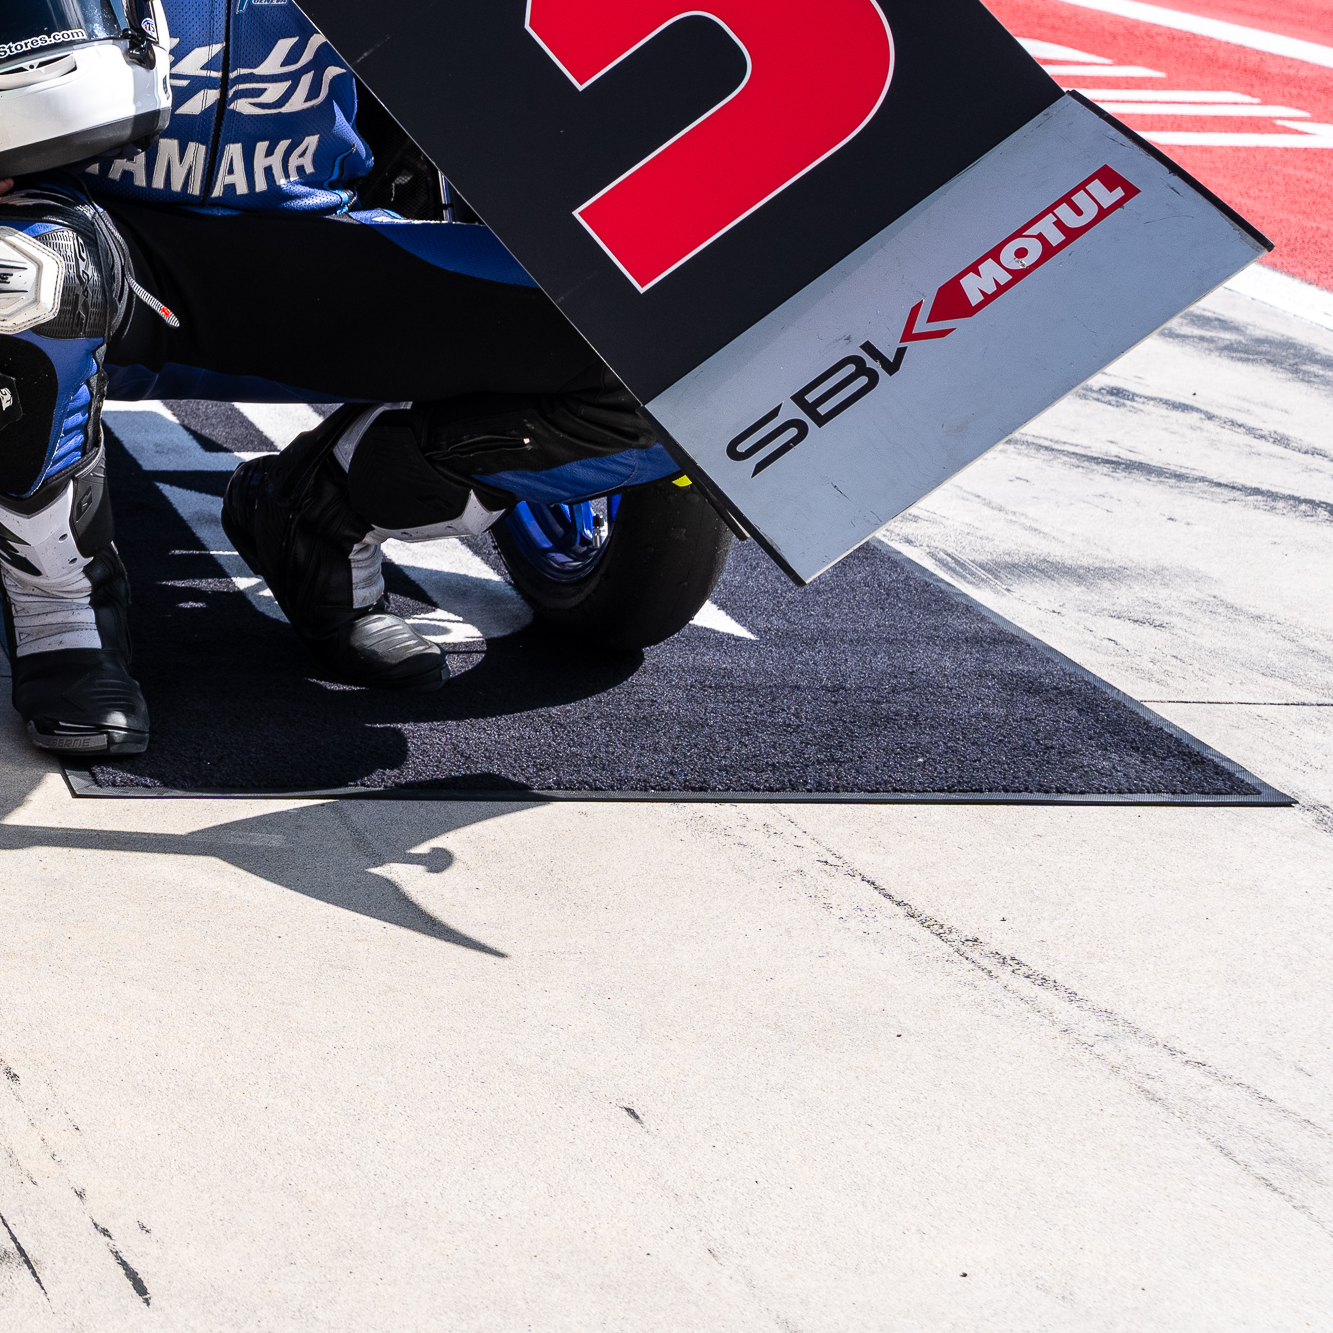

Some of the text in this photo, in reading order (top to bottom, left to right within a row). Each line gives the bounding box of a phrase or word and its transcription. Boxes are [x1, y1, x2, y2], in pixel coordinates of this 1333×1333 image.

[170, 33, 327, 78] LU
[170, 66, 347, 115] RU
[85, 134, 321, 198] AMAHA
[957, 177, 1127, 308] MOTUL
